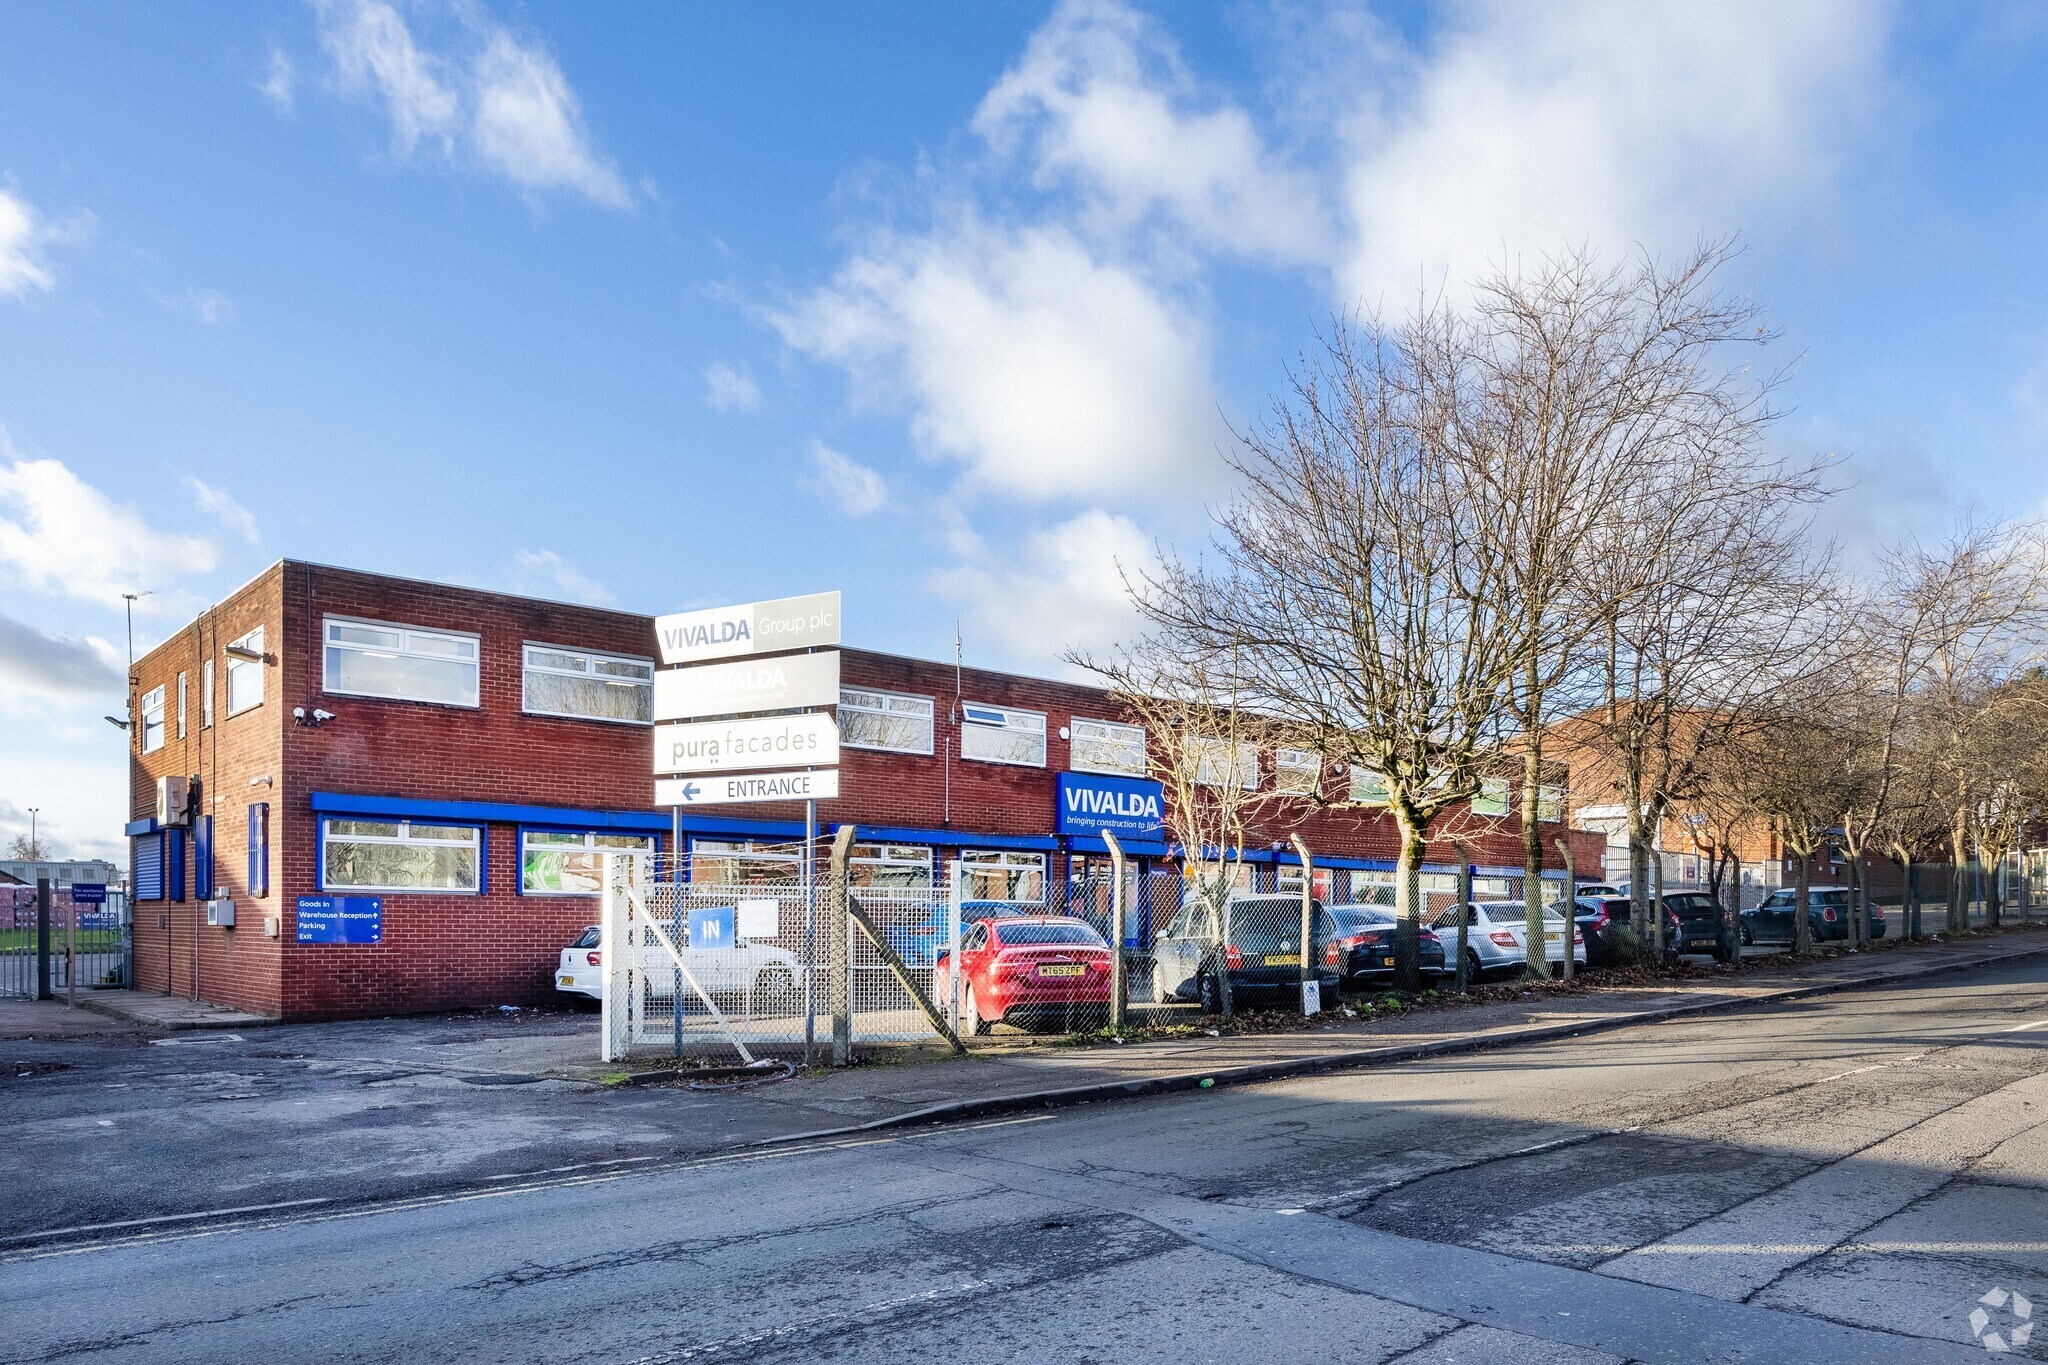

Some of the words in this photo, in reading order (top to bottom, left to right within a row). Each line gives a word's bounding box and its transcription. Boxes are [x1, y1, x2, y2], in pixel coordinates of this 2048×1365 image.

[664, 619, 751, 650] VIVALDA
[758, 617, 805, 636] Group
[810, 610, 833, 633] plc
[700, 665, 787, 695] VIVALDA
[727, 776, 811, 798] ENTRANCE
[1065, 787, 1160, 818] VIVALDA
[1066, 815, 1095, 827] bringing
[1096, 818, 1136, 829] construction
[1138, 820, 1145, 829] to
[299, 900, 322, 908] Goods
[298, 911, 338, 919] Warehouse
[339, 911, 373, 920] Reception
[299, 922, 326, 931] Parking
[703, 919, 720, 940] IN
